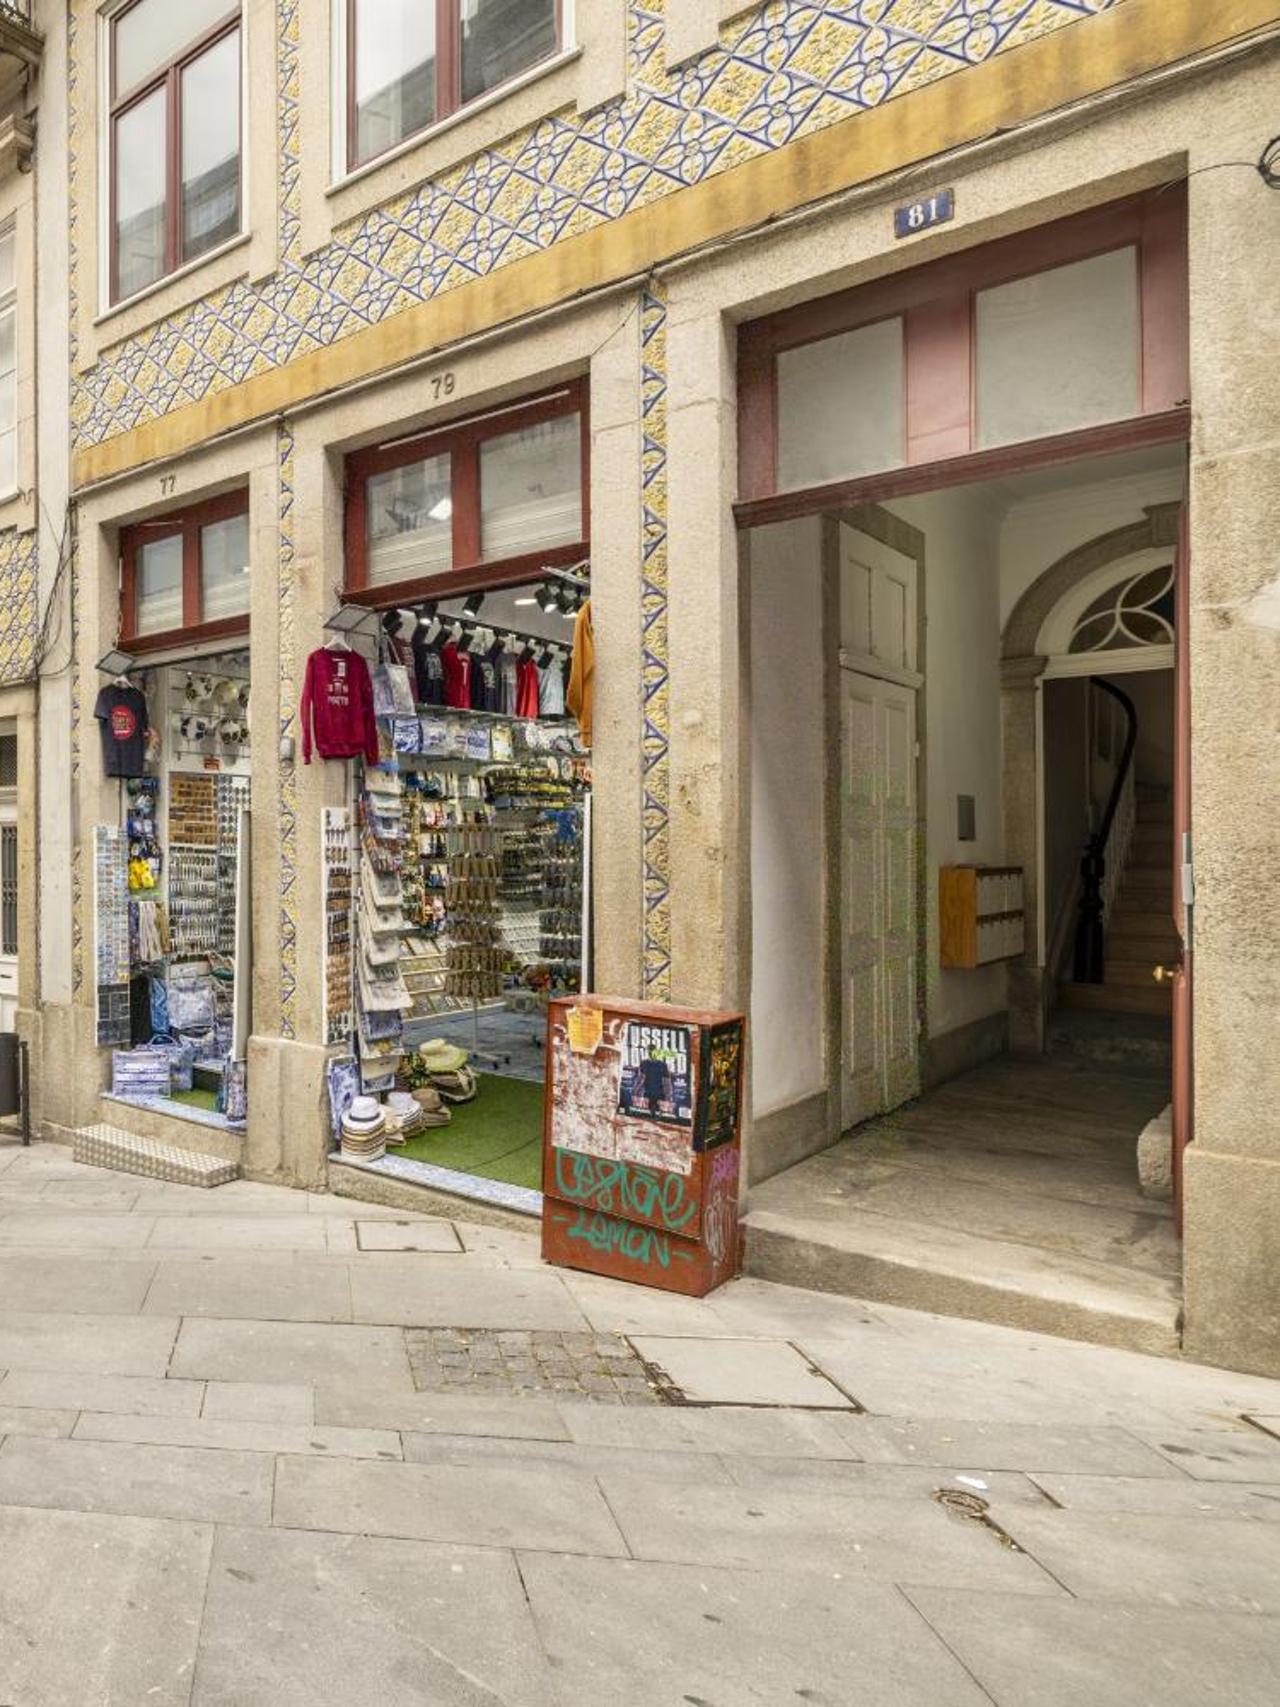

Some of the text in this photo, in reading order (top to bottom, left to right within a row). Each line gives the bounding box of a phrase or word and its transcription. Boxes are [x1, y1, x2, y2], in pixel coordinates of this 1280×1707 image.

[907, 198, 938, 228] 81
[431, 373, 455, 400] 79
[160, 474, 176, 496] 77
